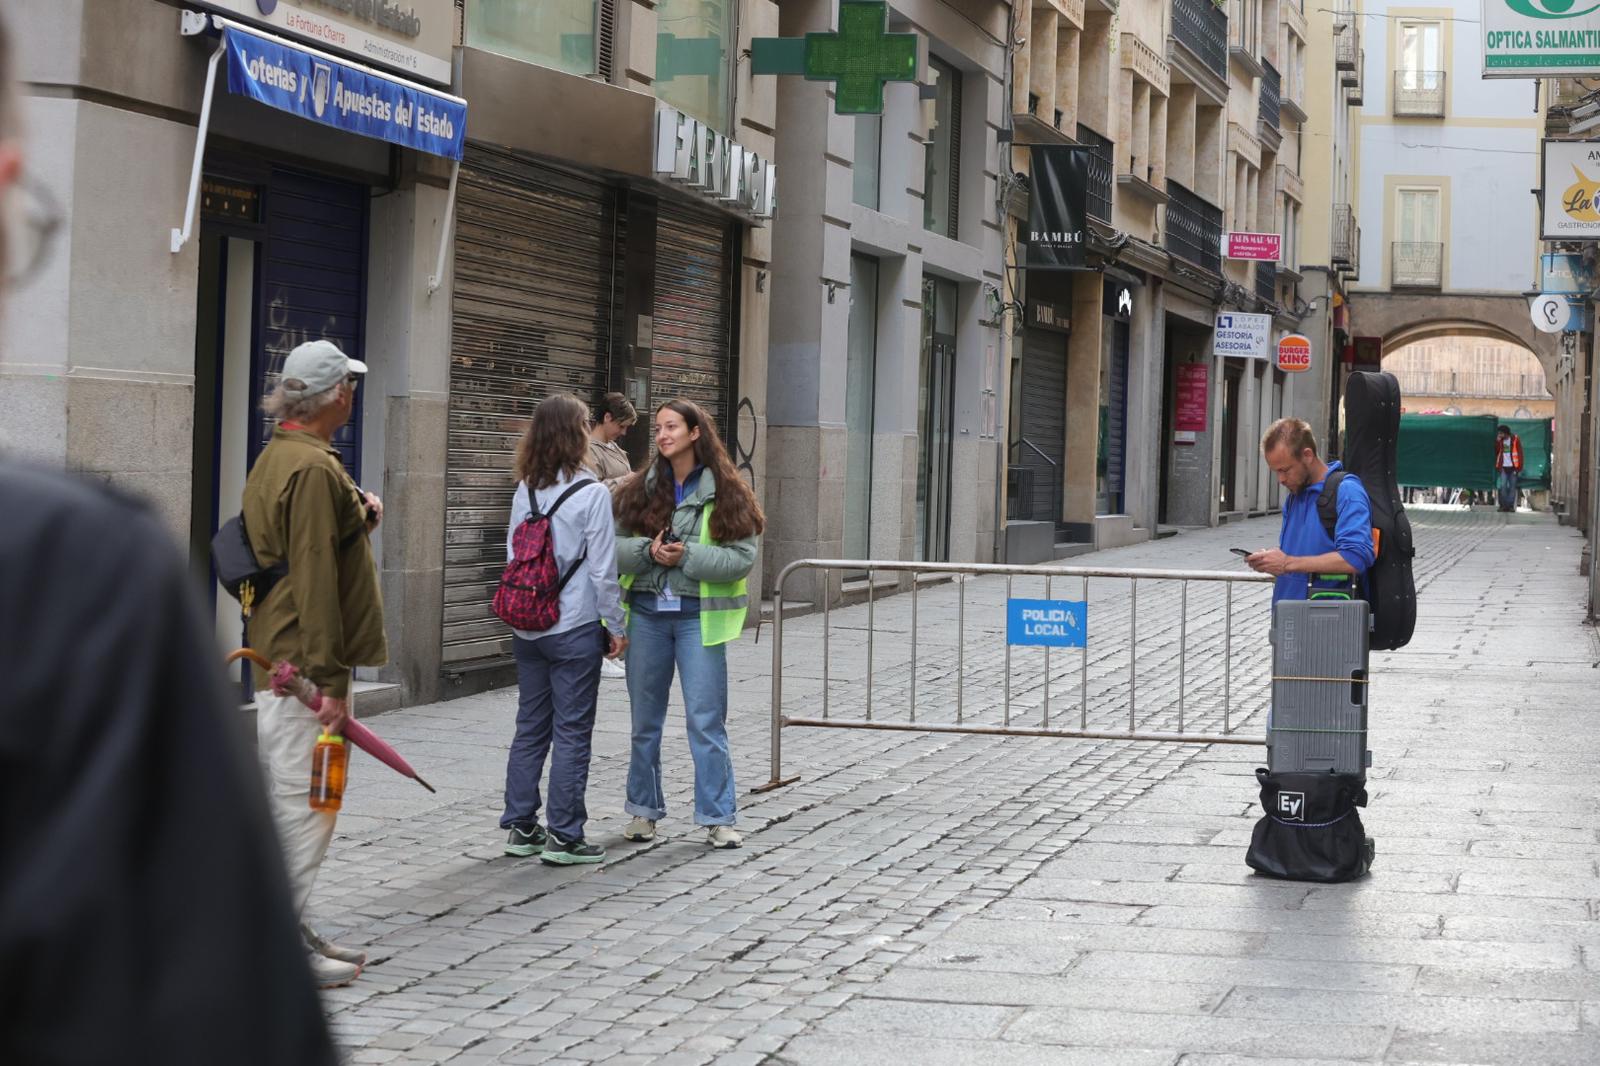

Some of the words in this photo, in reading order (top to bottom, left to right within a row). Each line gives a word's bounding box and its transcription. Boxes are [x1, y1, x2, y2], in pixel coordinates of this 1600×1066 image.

[296, 15, 323, 37] Fortuna
[1487, 30, 1533, 49] OPTICA
[333, 81, 391, 121] Apuestas
[395, 98, 413, 128] del
[417, 106, 454, 139] Estado
[1564, 189, 1593, 213] La
[1031, 231, 1082, 243] BAMBÚ
[1279, 346, 1310, 354] BURGER
[1279, 354, 1310, 364] KING
[1025, 623, 1069, 636] LOCAL
